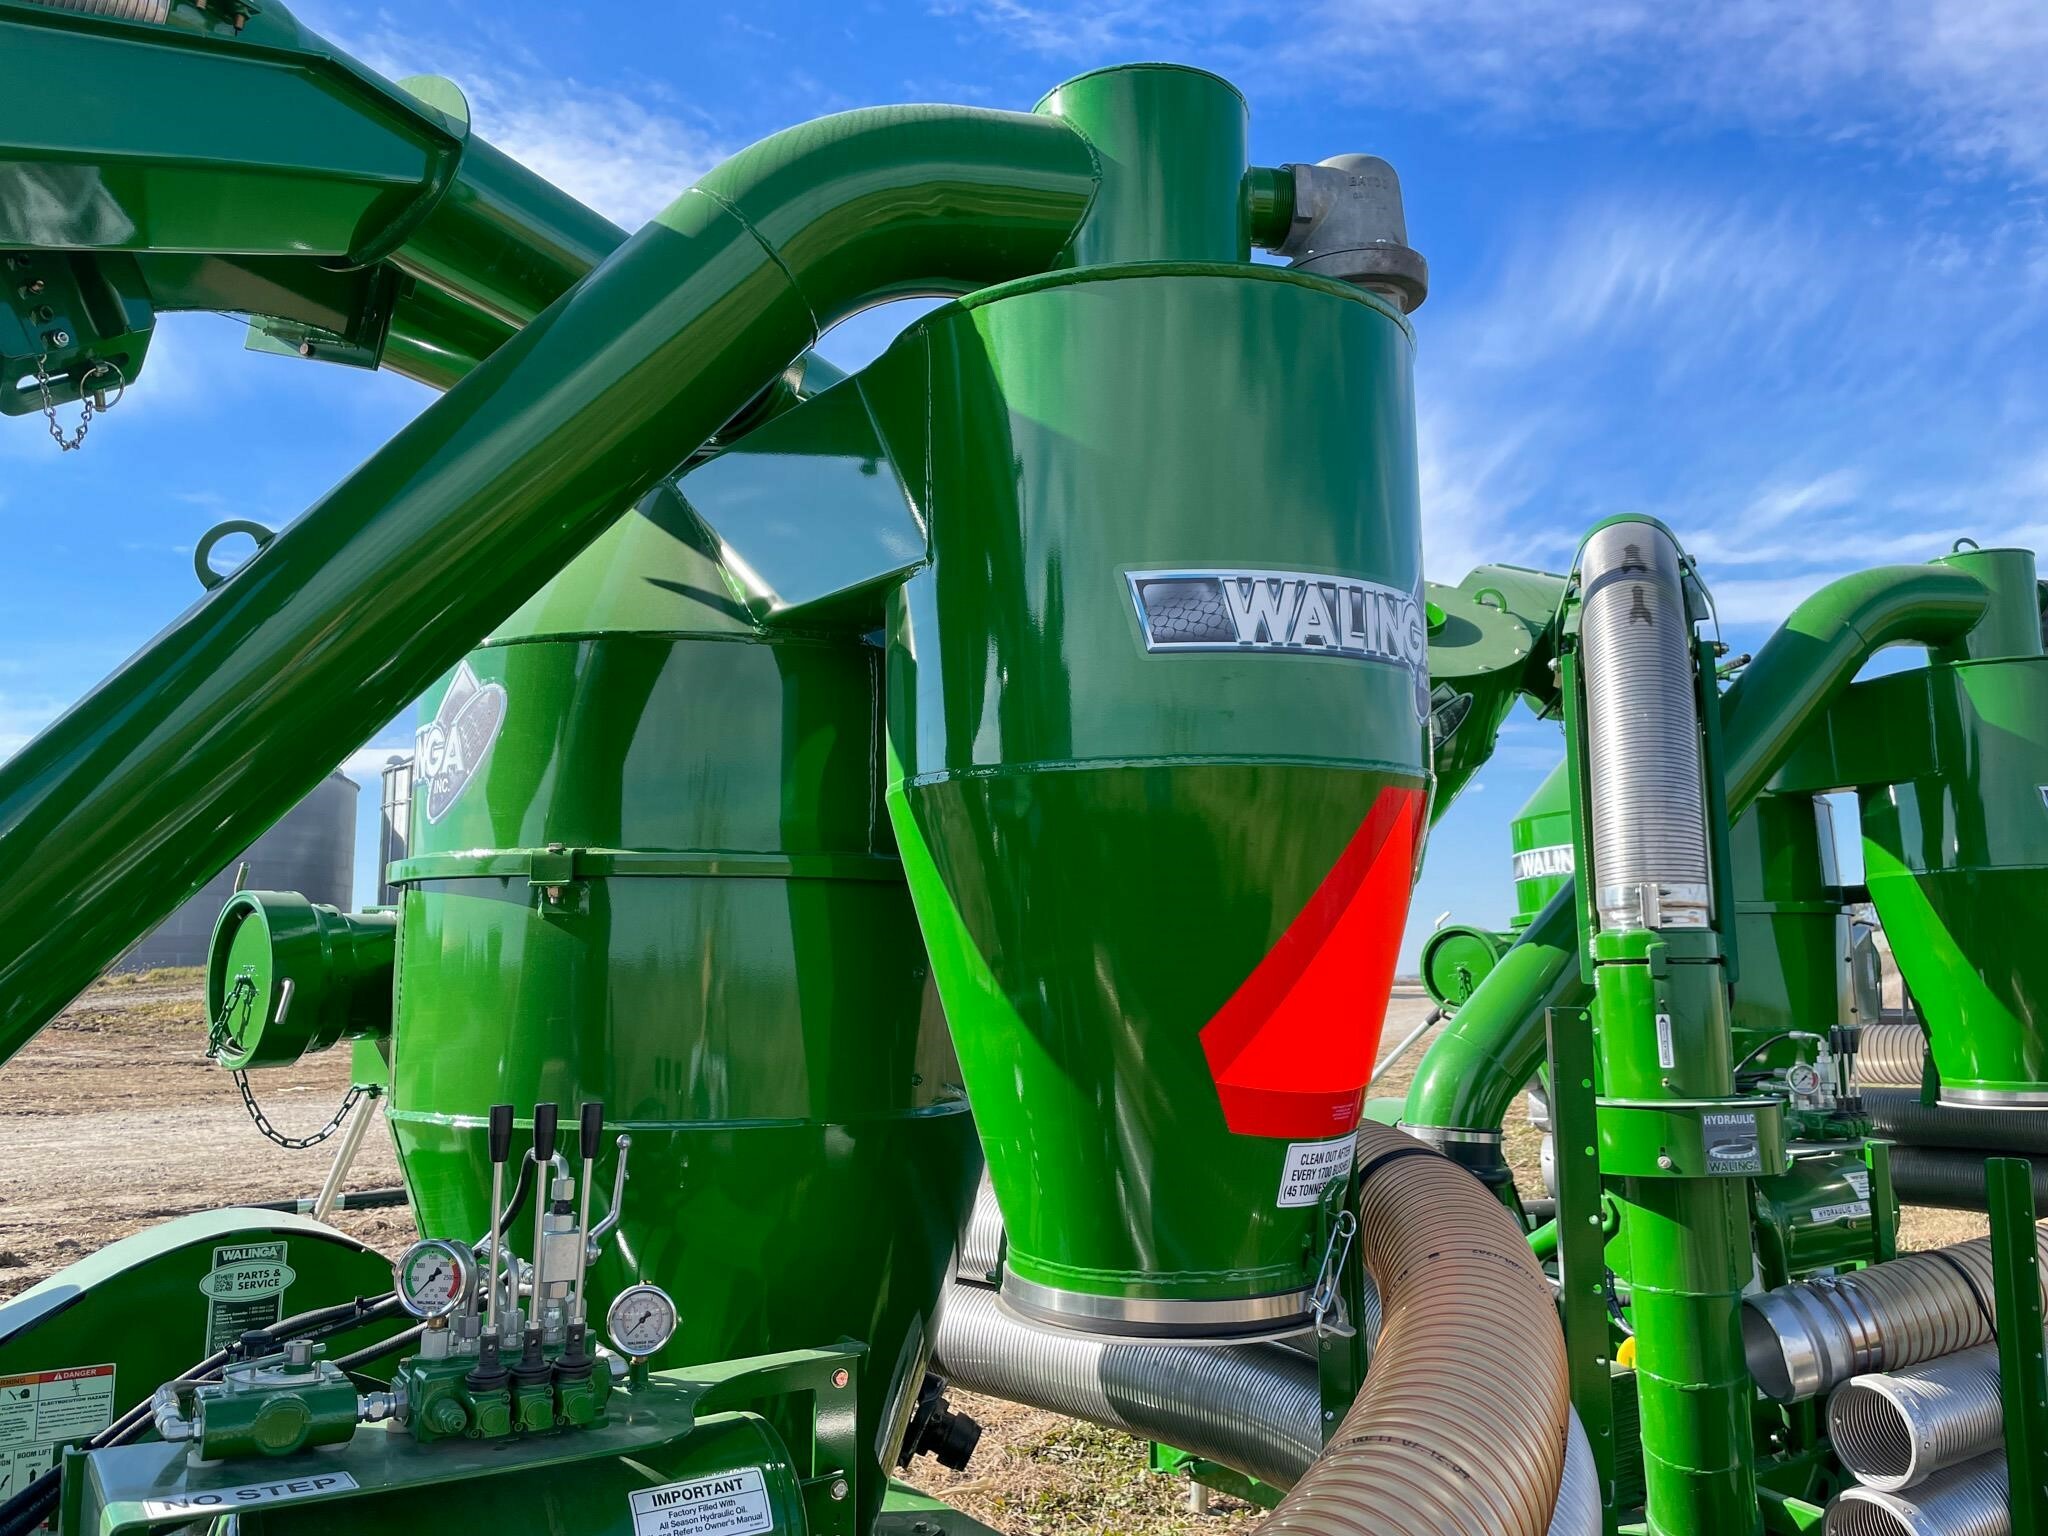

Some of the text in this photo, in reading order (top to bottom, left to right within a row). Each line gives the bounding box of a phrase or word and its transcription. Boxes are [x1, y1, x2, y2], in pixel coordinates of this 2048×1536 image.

[1219, 577, 1424, 665] WALING
[415, 730, 465, 778] NGA
[434, 779, 450, 793] INC.
[1521, 848, 1574, 877] WALIN
[1704, 1114, 1755, 1125] HYDRAULIC
[1300, 1152, 1325, 1166] CLEAN
[1325, 1150, 1338, 1163] OUT
[1292, 1168, 1316, 1181] EVERY
[1318, 1166, 1332, 1179] 1700
[1709, 1161, 1759, 1172] WALINGA
[1283, 1182, 1327, 1200] (45 TONNES
[1818, 1206, 1852, 1217] HYDRAULIC
[222, 1247, 278, 1261] WALINGA
[237, 1268, 281, 1280] PARTS &
[238, 1279, 280, 1290] SERVICE
[0, 1377, 26, 1386] RNING
[63, 1369, 97, 1379] DANGER
[17, 1451, 37, 1459] BOOM
[161, 1478, 337, 1510] NO STEP
[652, 1478, 743, 1507] IMPORTANT
[668, 1499, 736, 1518] Factory Filled With
[659, 1505, 748, 1530] All Season Hydraulic Oil.
[673, 1527, 694, 1536] Refer
[695, 1525, 703, 1533] to
[704, 1518, 735, 1530] Owner's
[736, 1512, 763, 1524] Manual
